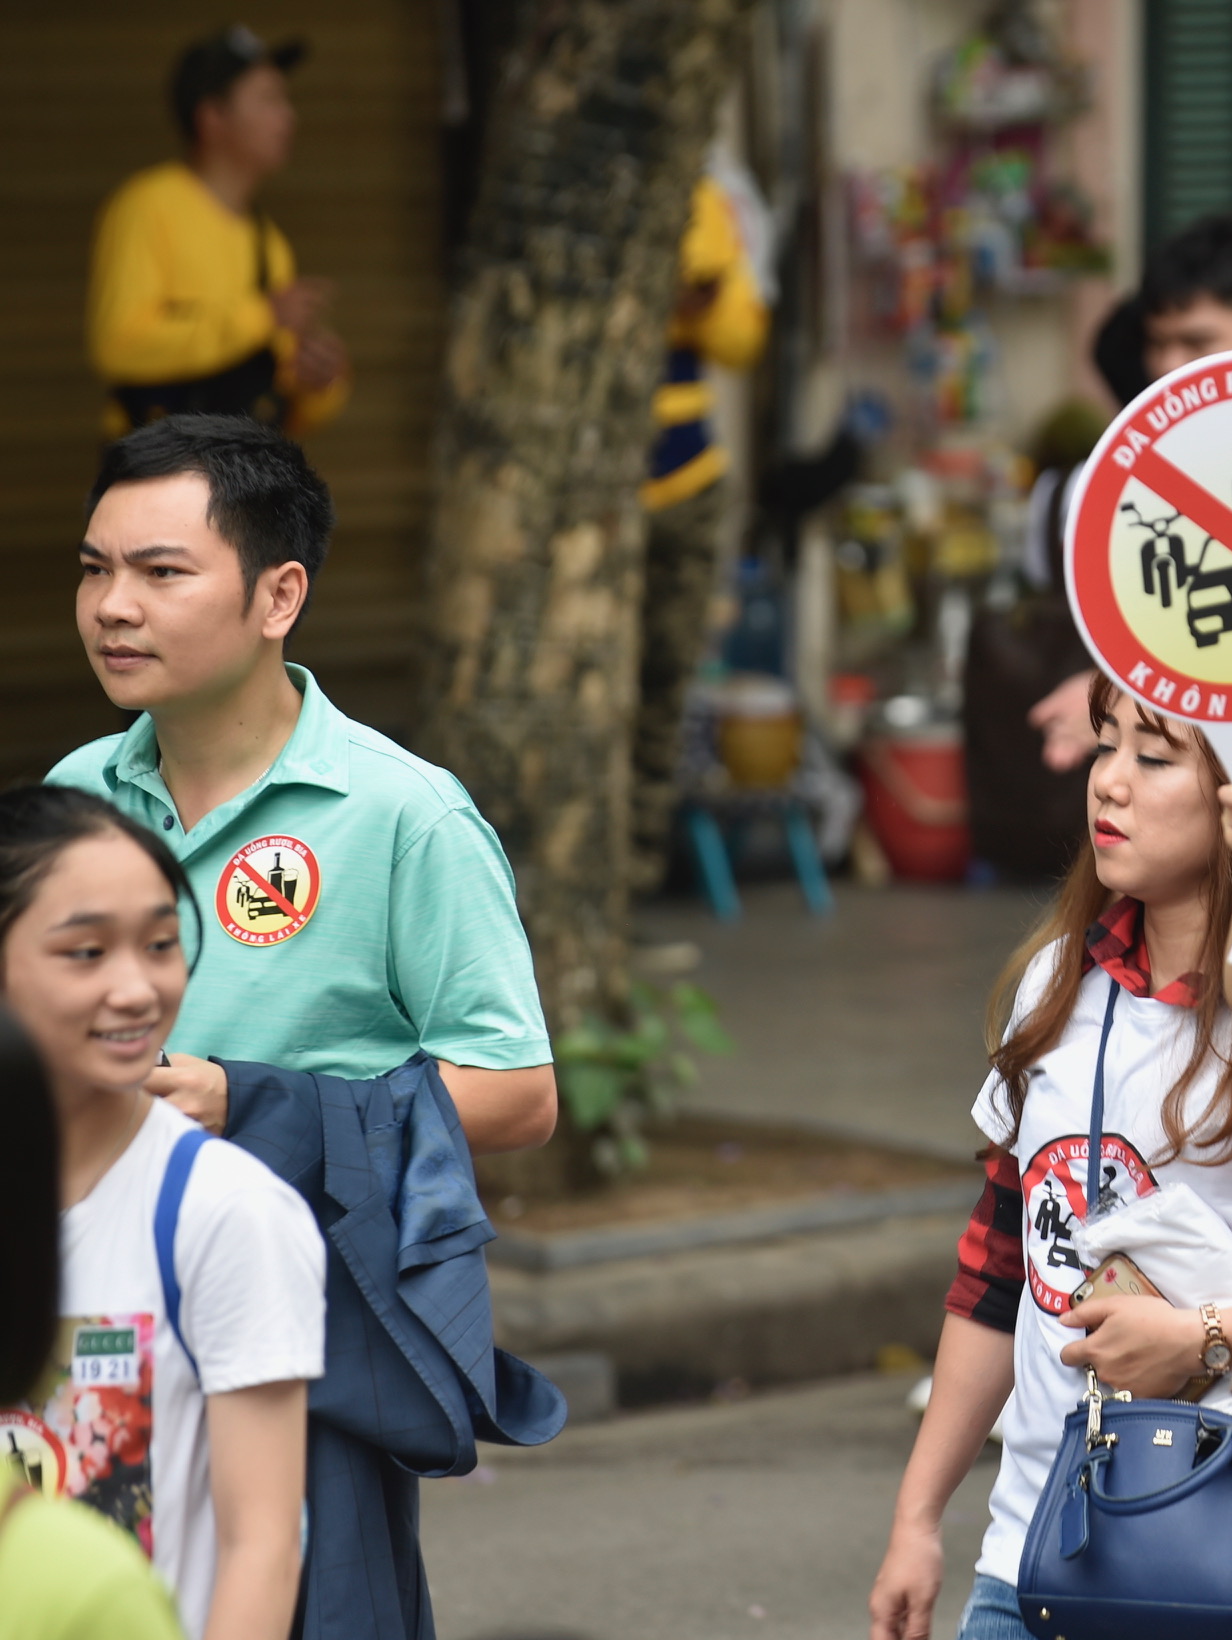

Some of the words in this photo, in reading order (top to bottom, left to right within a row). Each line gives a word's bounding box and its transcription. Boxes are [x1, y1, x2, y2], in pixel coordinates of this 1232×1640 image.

[1112, 426, 1150, 469] ĐÃ
[1146, 377, 1218, 431] UỐNG
[293, 843, 308, 858] BIA
[226, 923, 265, 943] KHÔNG
[292, 914, 307, 930] XE
